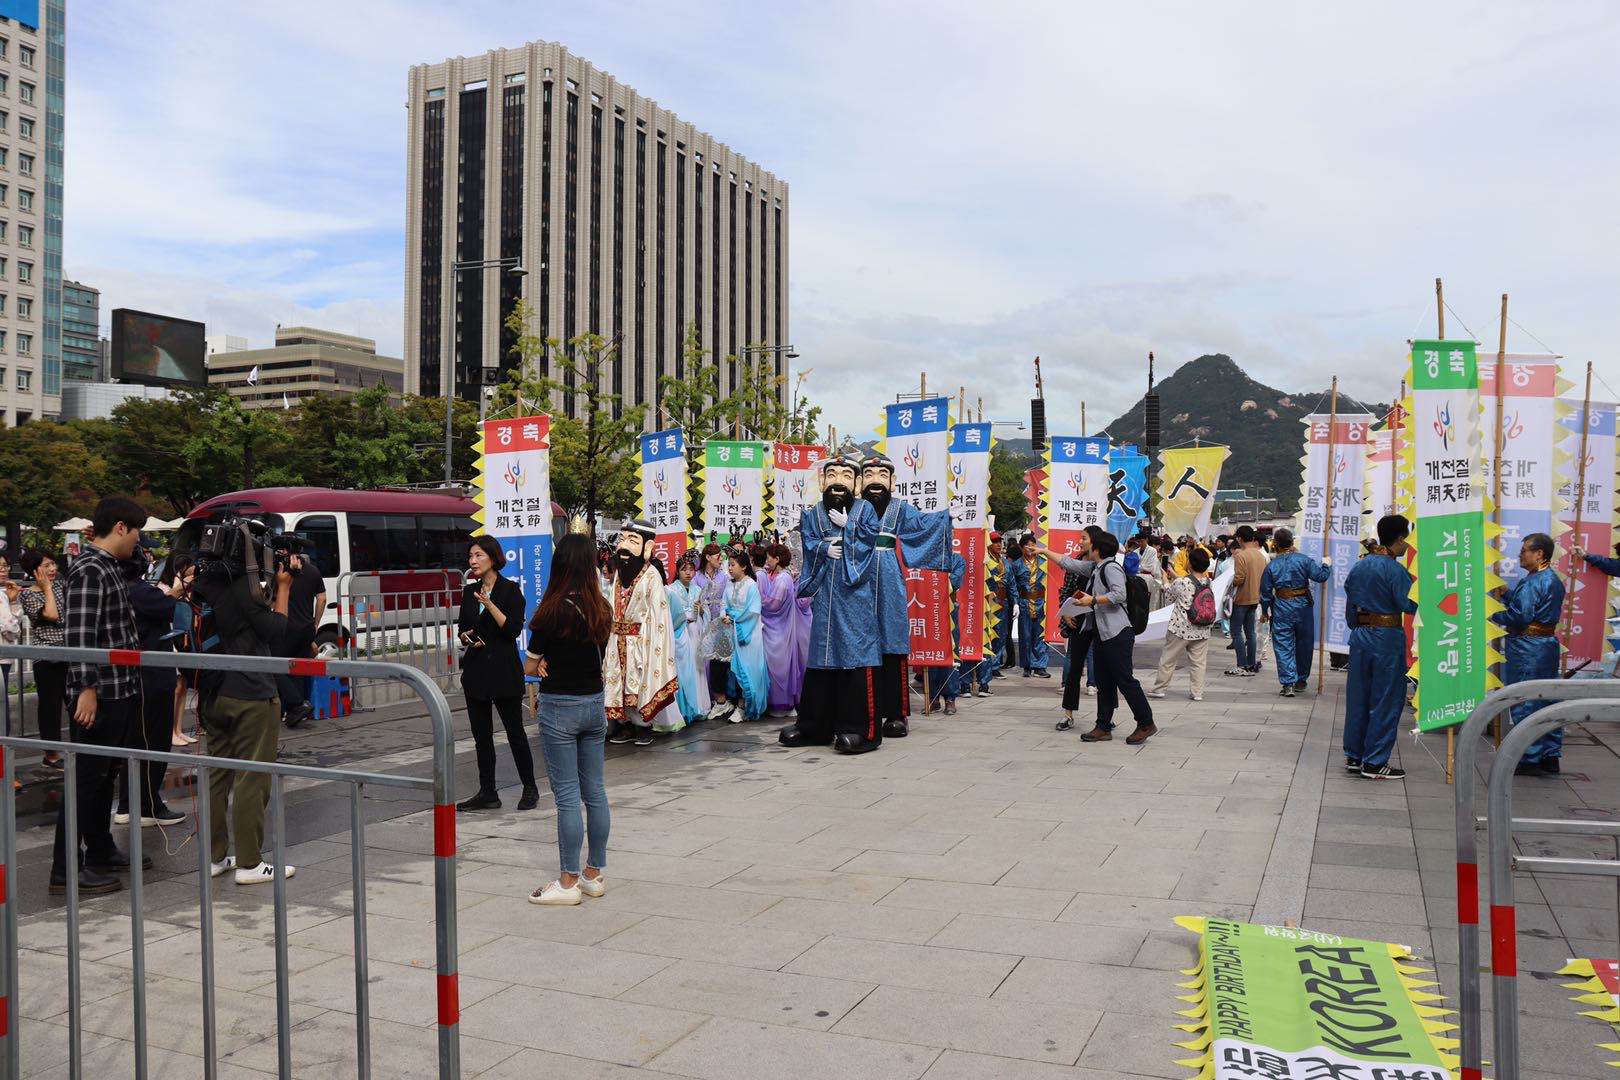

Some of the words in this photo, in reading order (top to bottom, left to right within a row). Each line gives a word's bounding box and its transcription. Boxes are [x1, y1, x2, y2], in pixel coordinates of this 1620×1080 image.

[1425, 458, 1470, 480] 개천절
[895, 480, 937, 496] 개천절
[1168, 466, 1209, 500] 人
[1426, 484, 1470, 504] 開天節
[495, 498, 540, 513] 개천절
[649, 500, 678, 514] 개천절
[714, 505, 752, 515] 개천절
[1058, 500, 1097, 512] 개천절
[496, 514, 541, 528] 開天節
[1058, 513, 1097, 525] 開天節
[534, 544, 542, 556] For
[1462, 528, 1472, 558] Love
[534, 559, 542, 572] the
[968, 536, 976, 574] Happiness
[1436, 531, 1458, 589] 지구
[1464, 563, 1473, 582] for
[534, 574, 542, 596] peace
[1464, 588, 1474, 621] Earth
[966, 602, 976, 634] Mankind
[1437, 620, 1459, 677] 사랑
[1465, 626, 1474, 673] Human
[1295, 944, 1412, 1058] KOREA
[1216, 995, 1253, 1040] HAPPY
